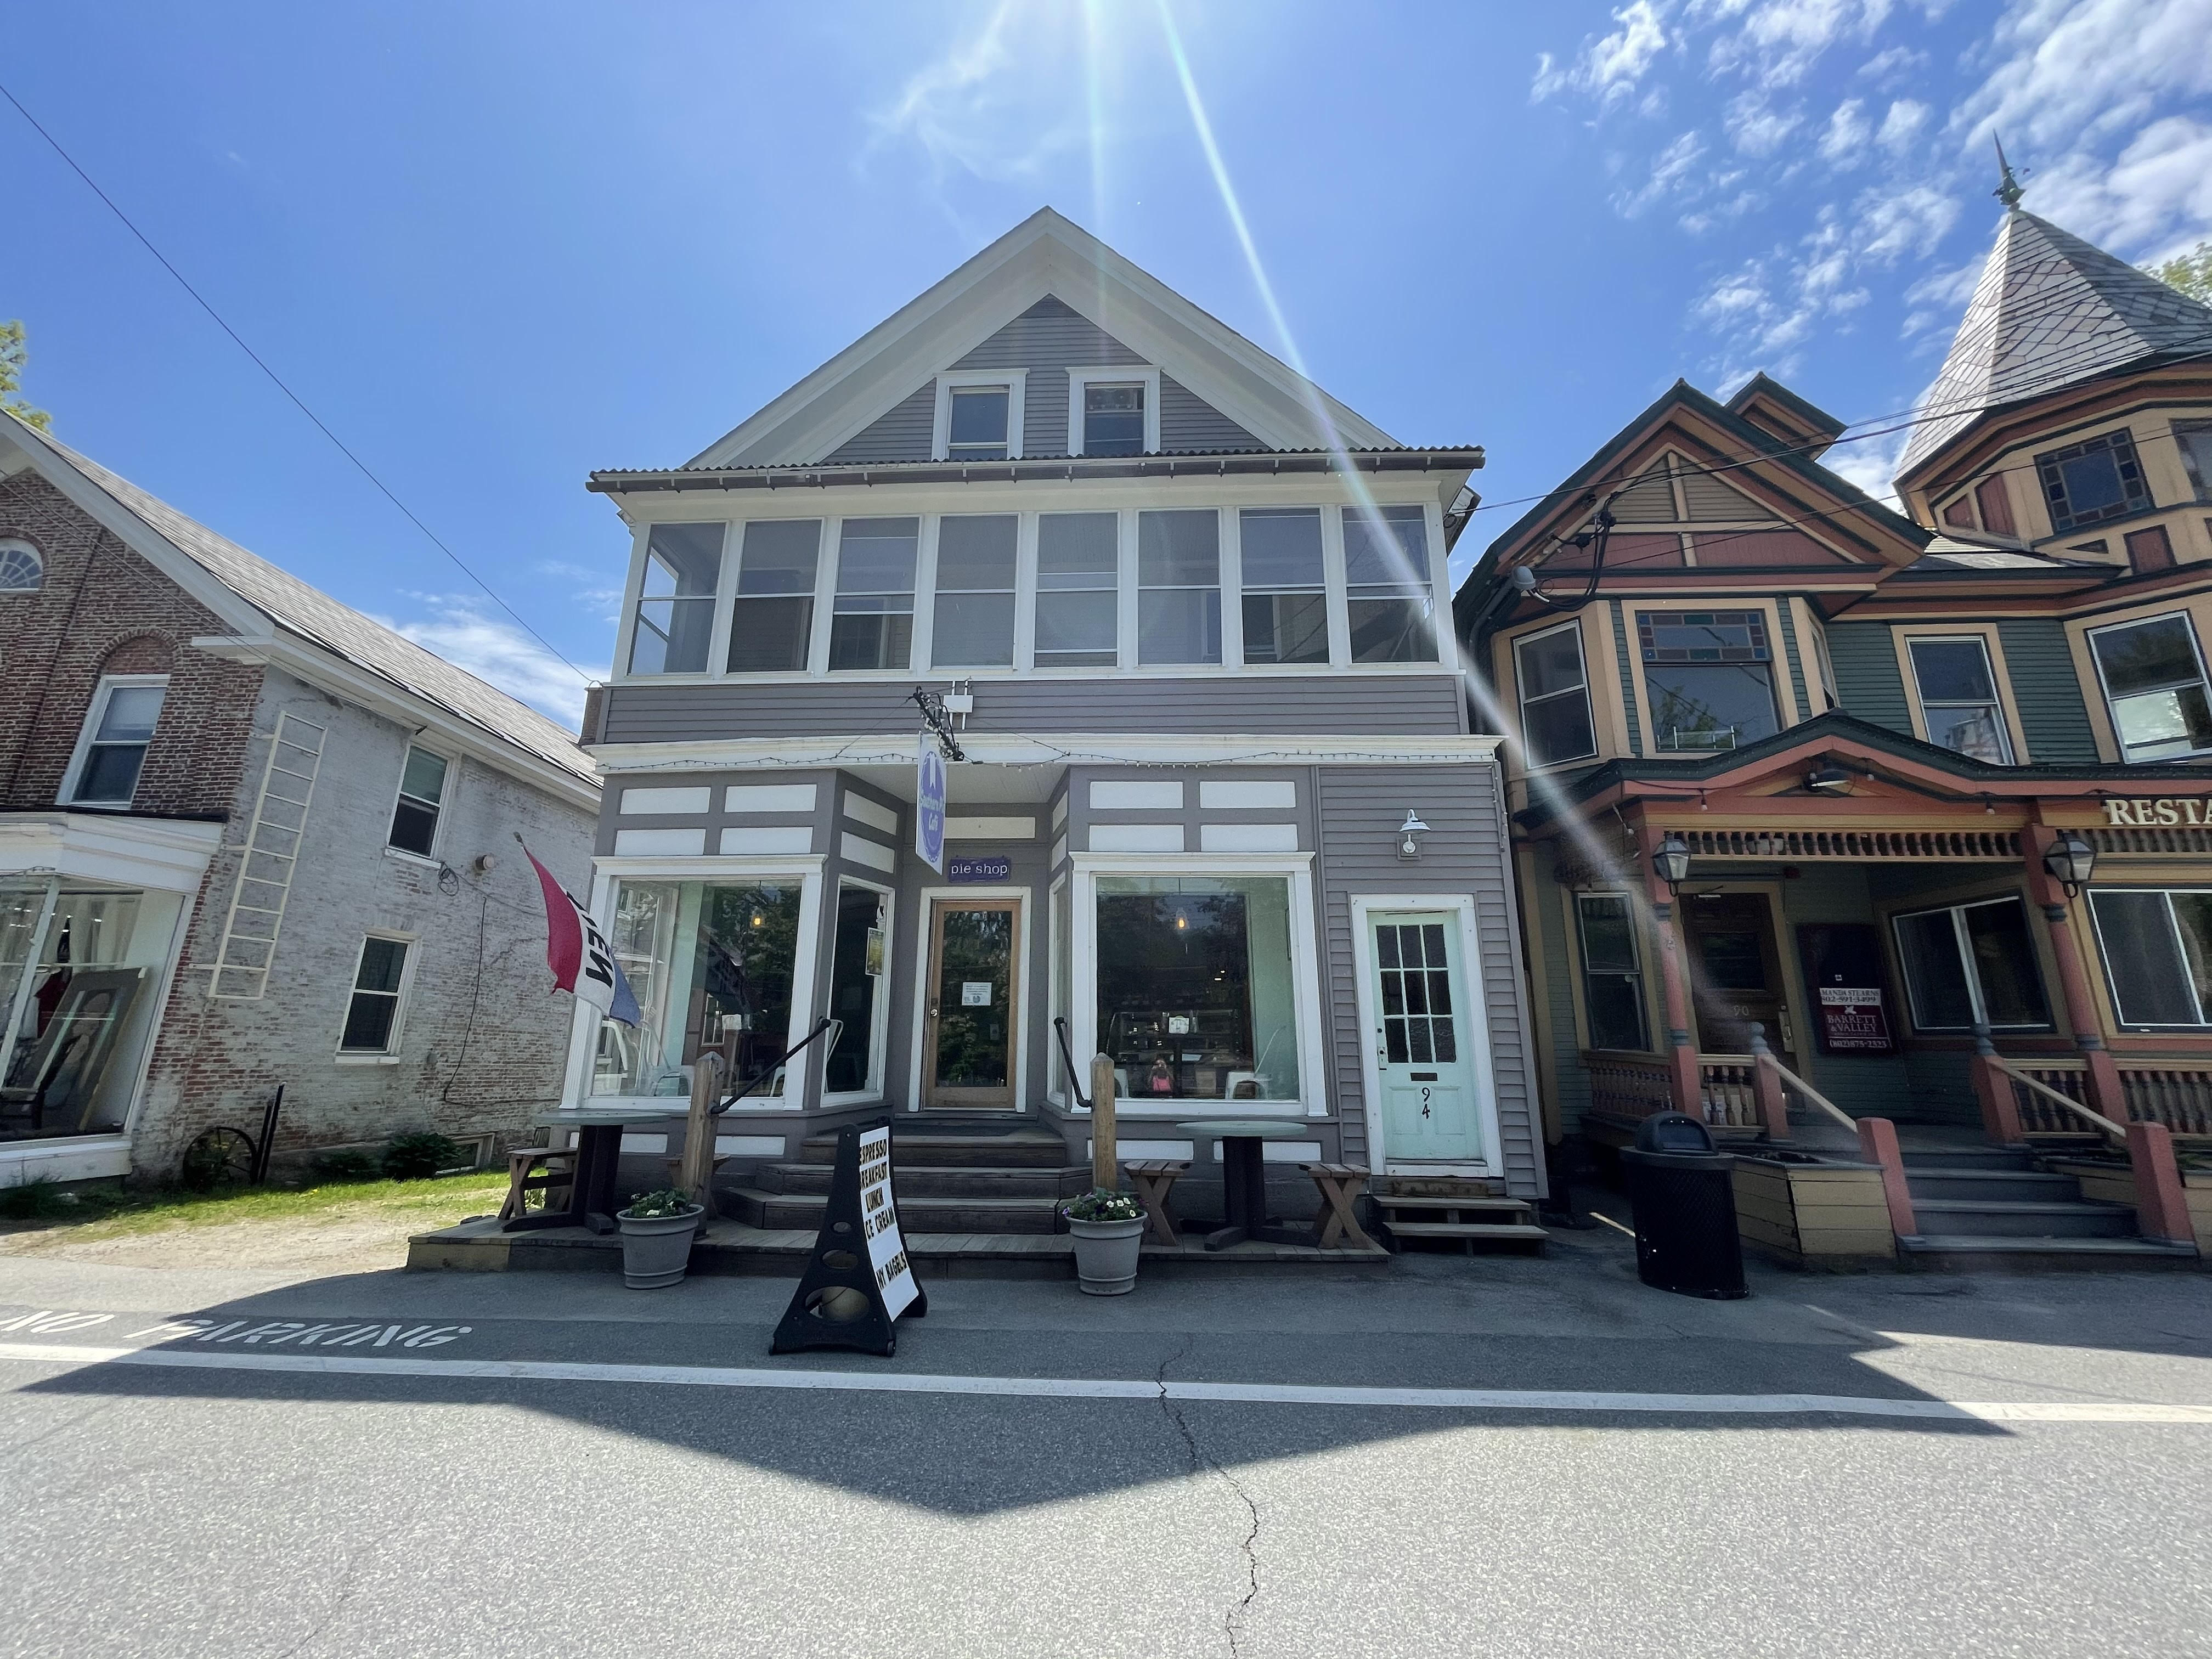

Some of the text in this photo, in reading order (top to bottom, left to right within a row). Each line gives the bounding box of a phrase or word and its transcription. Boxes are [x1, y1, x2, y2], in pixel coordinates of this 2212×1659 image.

[951, 864, 1008, 876] pie shop
[1827, 1015, 1876, 1024] BARRETT
[865, 1187, 884, 1214] LUNCH
[865, 1206, 895, 1240] CE CREAM
[885, 1250, 907, 1282] BAGELS
[123, 1318, 472, 1348] PARKING
